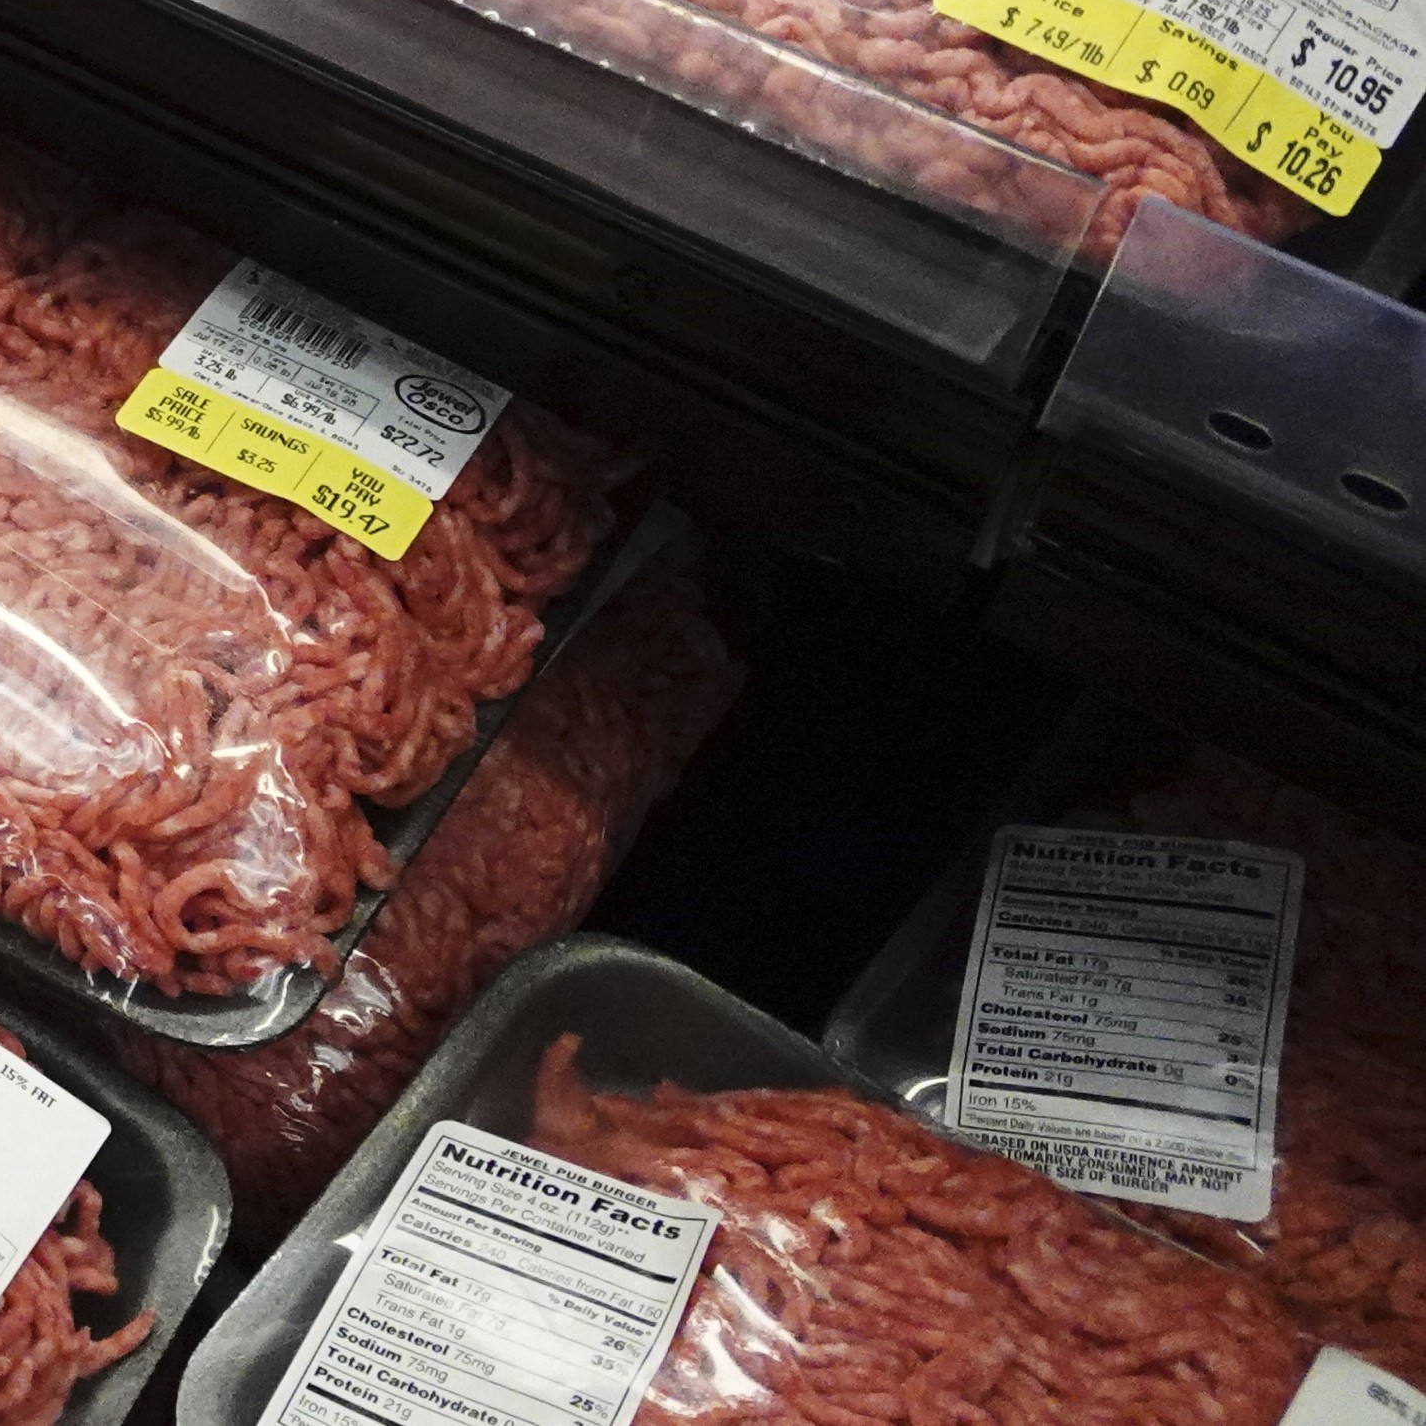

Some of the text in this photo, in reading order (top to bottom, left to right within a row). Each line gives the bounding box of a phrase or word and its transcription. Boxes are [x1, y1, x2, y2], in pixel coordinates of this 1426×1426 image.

[1158, 19, 1238, 73] Savings
[1168, 71, 1216, 110] 0.69
[1325, 59, 1394, 115] 10.95
[1304, 126, 1344, 159] Pay
[1319, 110, 1354, 144] You
[1277, 140, 1342, 196] 10.26
[145, 407, 201, 440] $5.99/lb
[240, 418, 311, 455] SAVINGS
[236, 448, 278, 474] $3.25
[312, 484, 390, 535] $19.47
[1013, 842, 1262, 880] Nutrition Facts
[980, 1002, 1089, 1026] Cholesterol
[0, 1064, 28, 1091] 15%
[31, 1086, 57, 1109] FAT
[441, 1142, 682, 1240] Nutrition Facts
